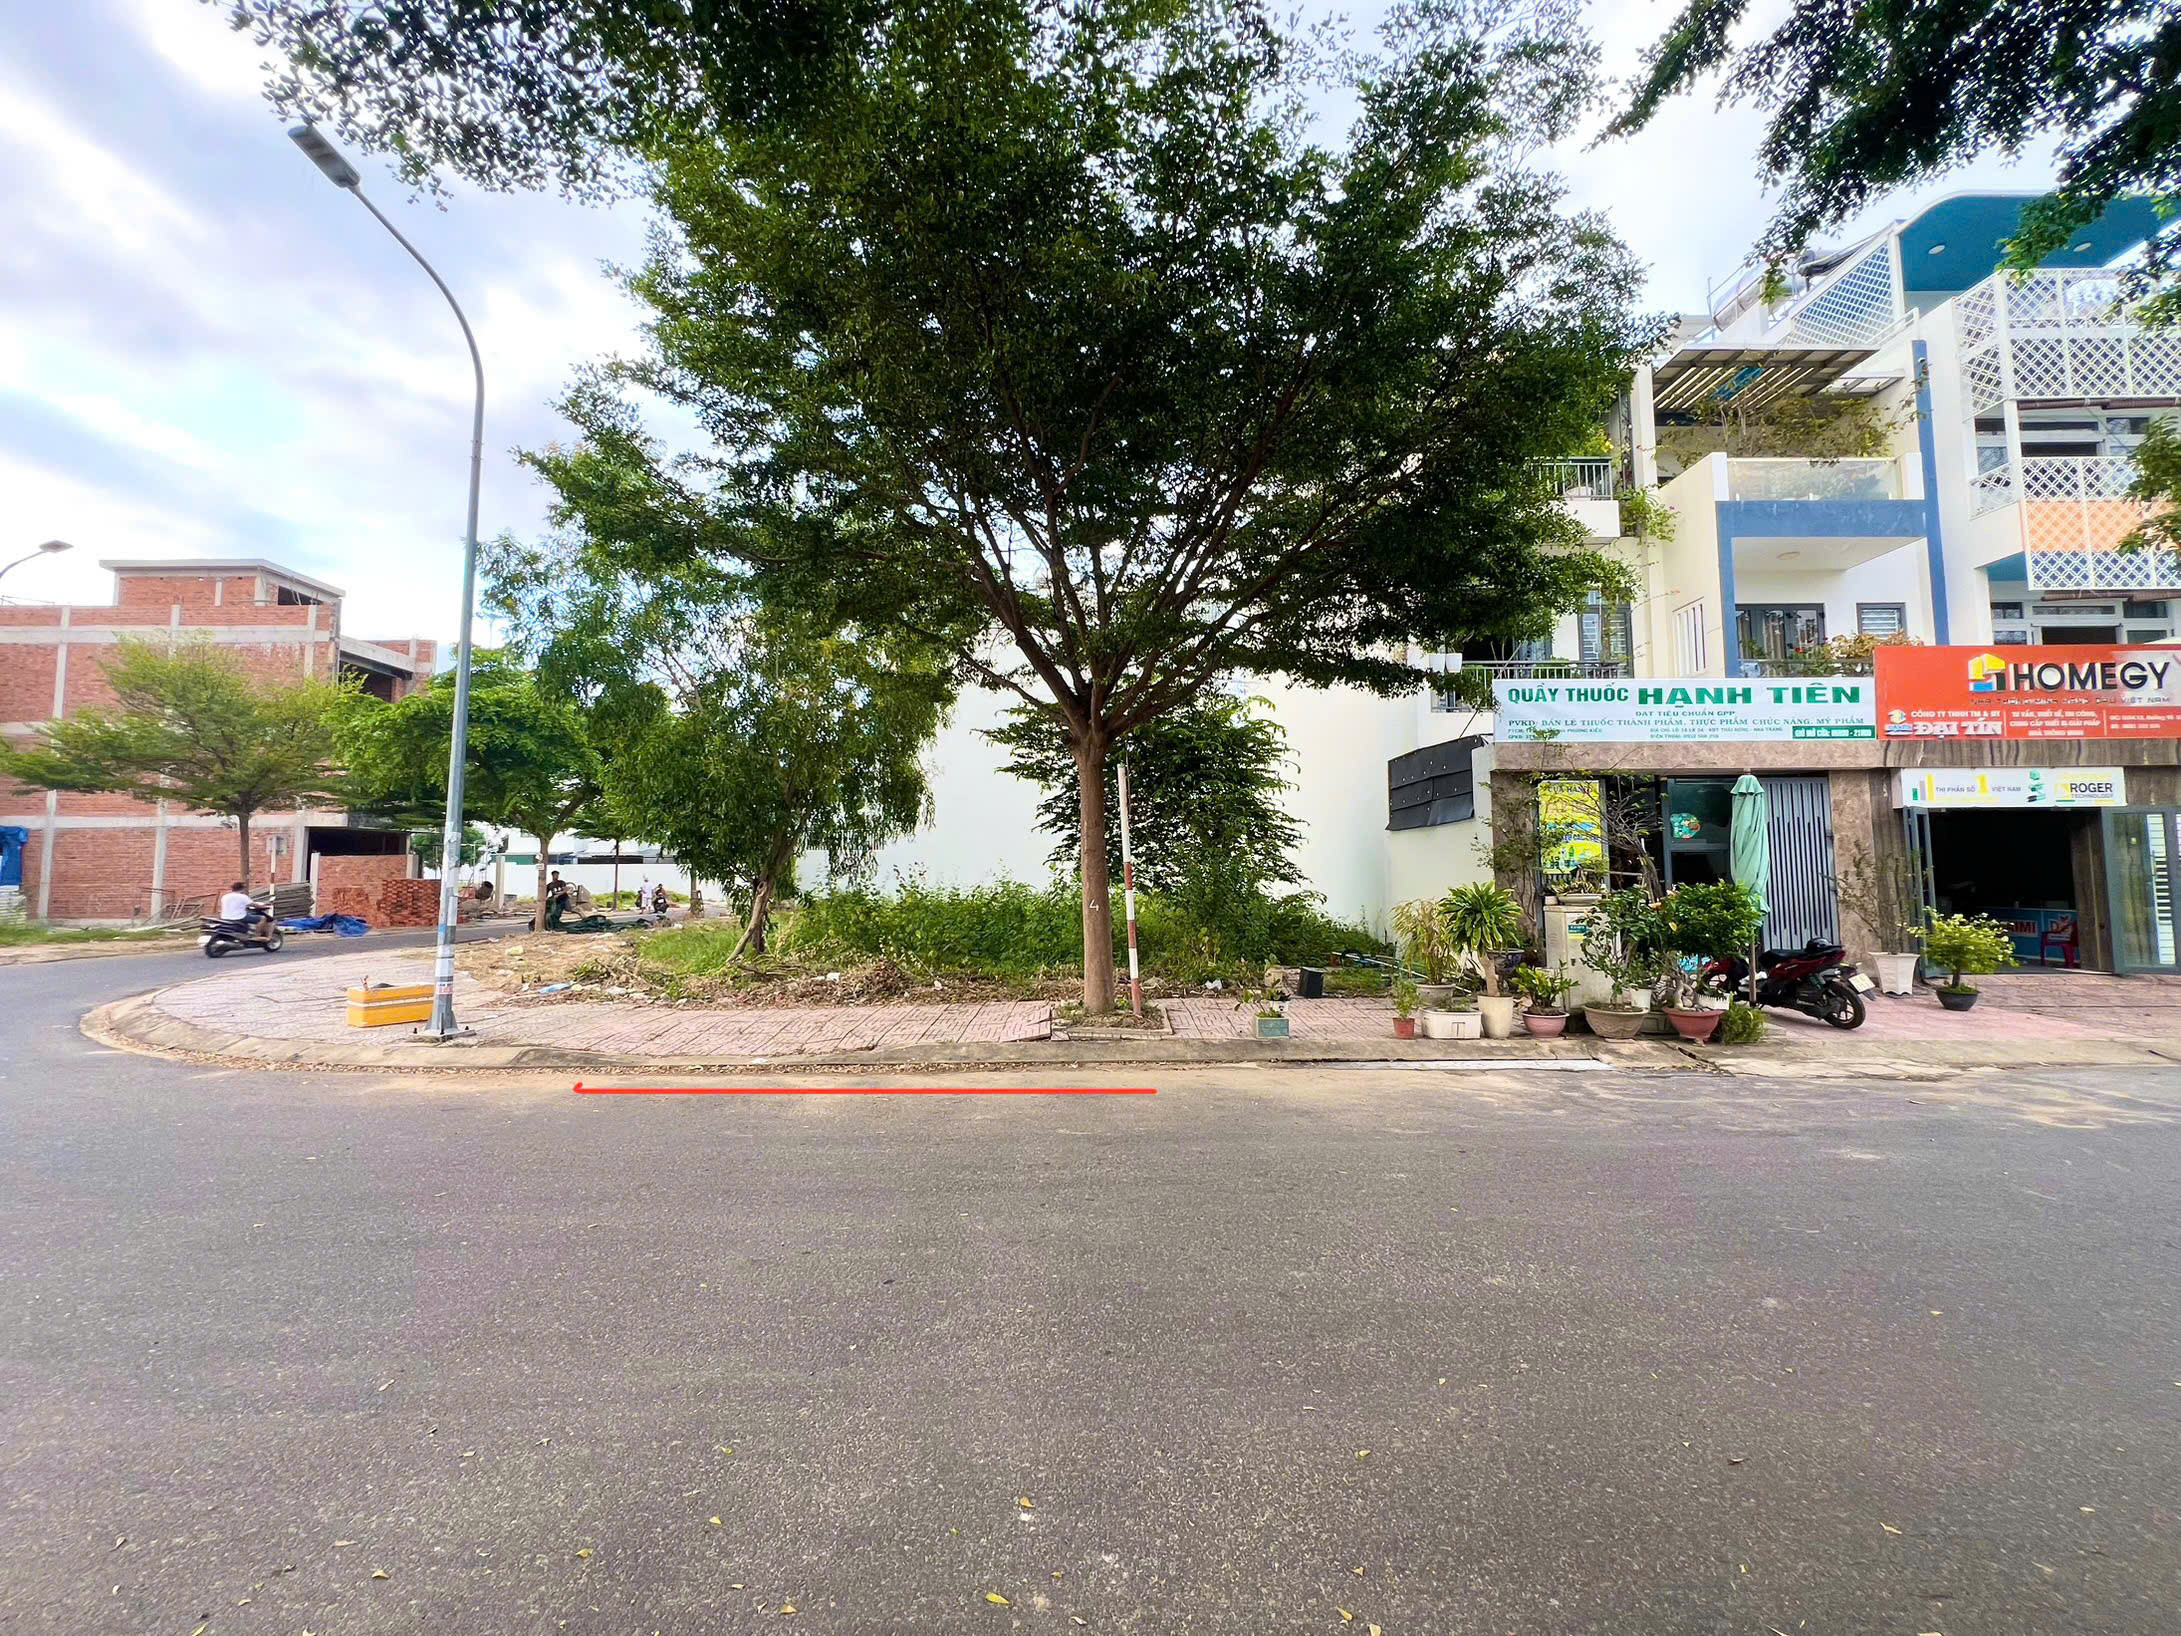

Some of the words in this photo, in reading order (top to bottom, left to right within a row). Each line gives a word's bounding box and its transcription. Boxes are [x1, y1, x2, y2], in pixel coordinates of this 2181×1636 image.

[2009, 662, 2170, 691] HOMEGY
[1508, 683, 1559, 704] QUẦY
[1565, 682, 1629, 703] THUỐC
[1638, 687, 1752, 708] HẠNH
[1767, 682, 1860, 704] TIÊN
[1913, 721, 1959, 739] ĐẠI
[1960, 717, 2003, 735] TÍN
[2070, 783, 2113, 793] ROGER
[1089, 898, 1099, 911] 4
